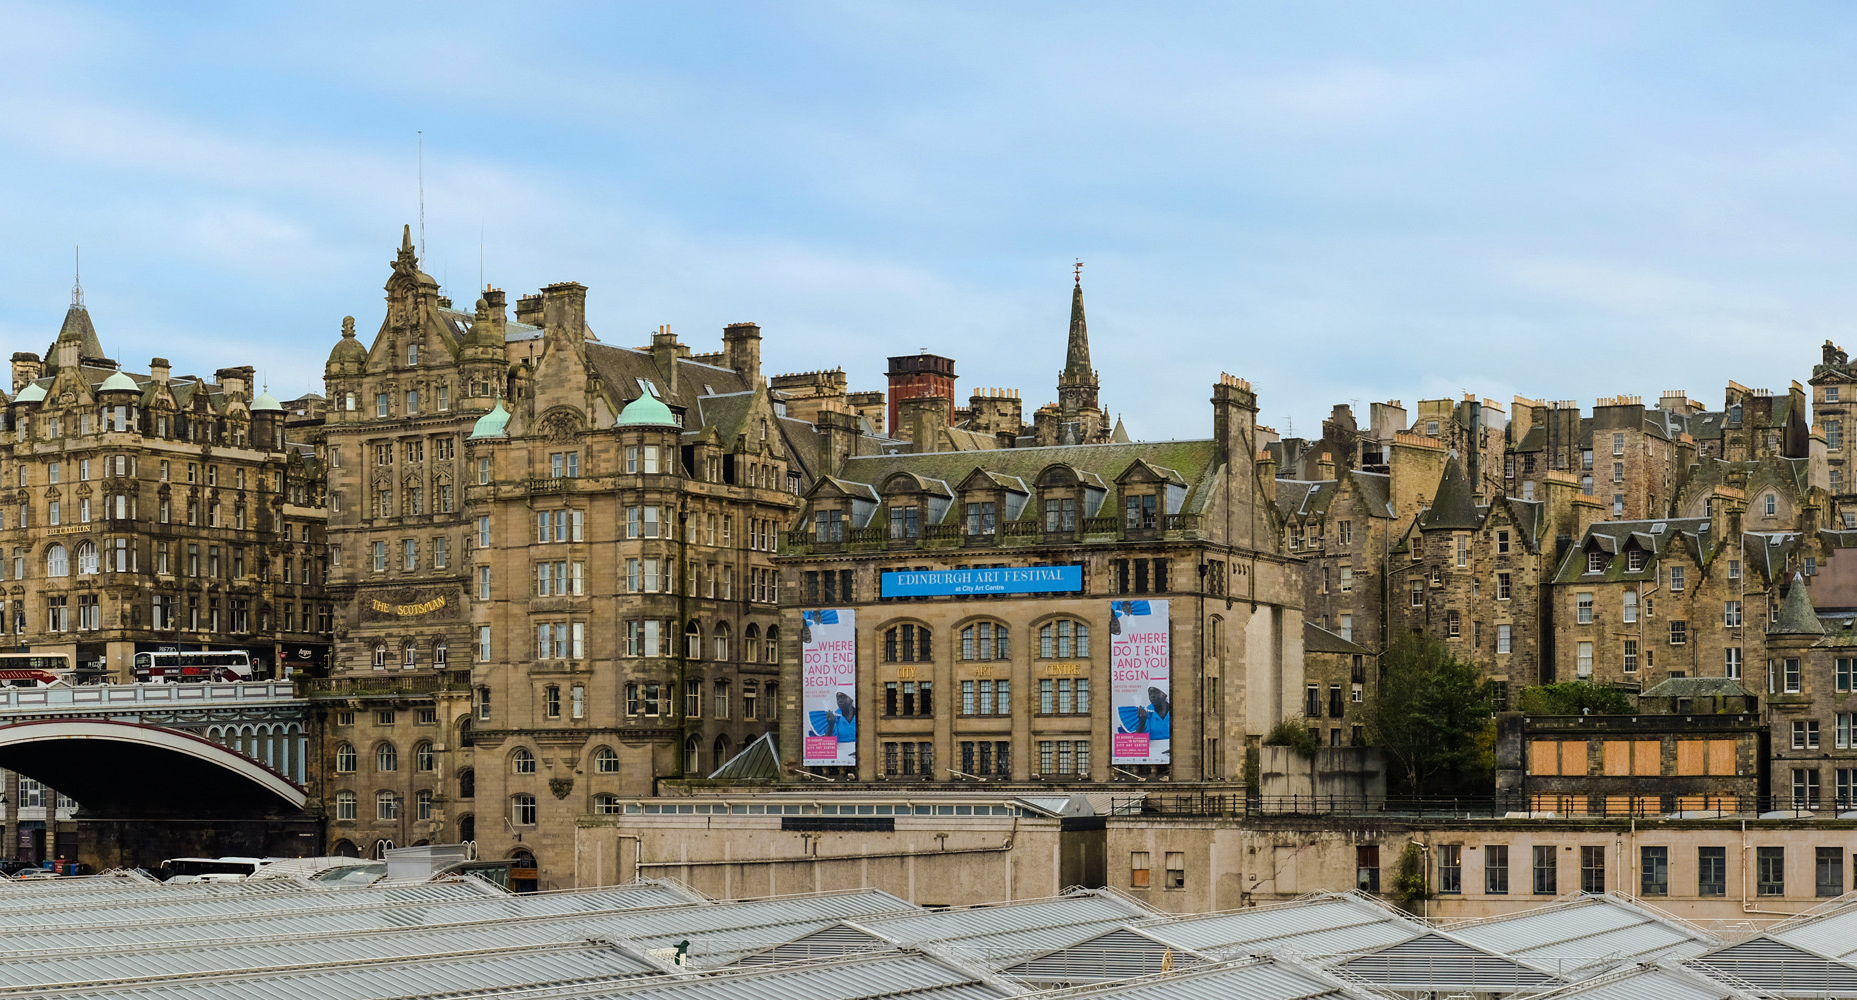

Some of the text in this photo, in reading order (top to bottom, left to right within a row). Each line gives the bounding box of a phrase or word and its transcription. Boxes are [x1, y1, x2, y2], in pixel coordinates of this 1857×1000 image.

[897, 569, 1064, 585] EDINBURGH ART FESTIVAL
[962, 585, 974, 593] City
[372, 595, 446, 616] THE SCOTSMAN
[1128, 633, 1167, 644] WHERE
[818, 641, 853, 651] WHERE
[1114, 646, 1132, 656] DO
[1136, 645, 1140, 656] I
[298, 648, 312, 657] Argos
[805, 653, 821, 663] DO
[825, 653, 828, 663] I
[1117, 657, 1167, 668] AND YOU
[808, 664, 853, 675] AND YOU
[897, 663, 1081, 678] CITY ART CENTRE
